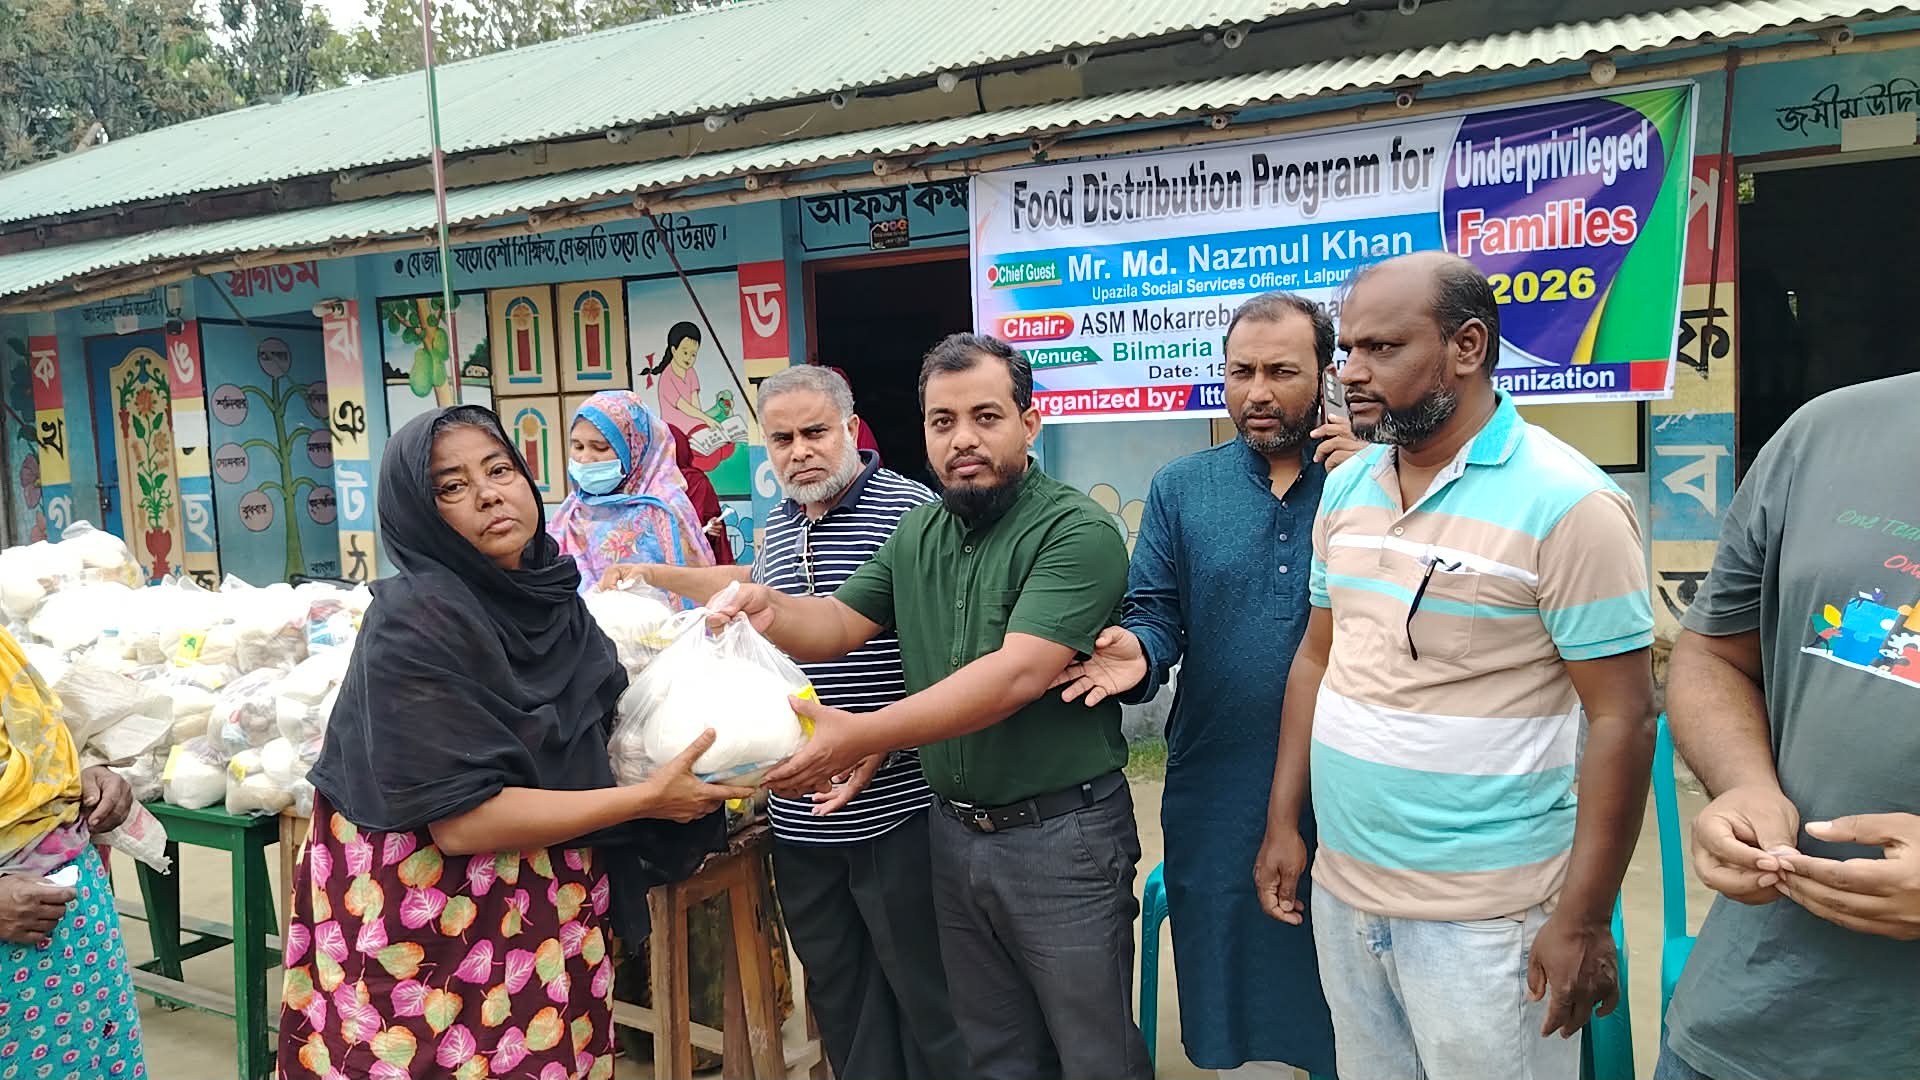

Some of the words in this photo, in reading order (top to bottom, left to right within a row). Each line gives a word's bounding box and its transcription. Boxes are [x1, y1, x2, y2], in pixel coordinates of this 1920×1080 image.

[1455, 119, 1649, 193] Underprivileged
[1013, 176, 1074, 230] Food
[1083, 160, 1242, 224] Distribution
[1252, 152, 1380, 215] Program
[1391, 135, 1435, 192] for
[1458, 201, 1635, 255] Families
[998, 264, 1024, 284] Chief
[1026, 262, 1056, 280] Guest
[1068, 253, 1111, 283] Mr.
[1122, 247, 1177, 279] Md.
[1188, 233, 1309, 273] Nazmul
[1322, 229, 1413, 261] Khan
[1092, 283, 1138, 302] Upazila
[1141, 279, 1183, 298] Social
[1186, 275, 1245, 295] Services
[1249, 271, 1300, 288] Officer,
[1489, 267, 1597, 305] 2026
[741, 283, 781, 338] ড
[1003, 317, 1066, 338] Chair:
[1080, 310, 1126, 336] ASM
[31, 350, 57, 389] ক
[1027, 348, 1088, 365] Venue:
[1113, 337, 1212, 362] Bilmaria
[1149, 364, 1199, 380] Date:
[1147, 386, 1186, 413] by:
[1654, 444, 1731, 518] ব
